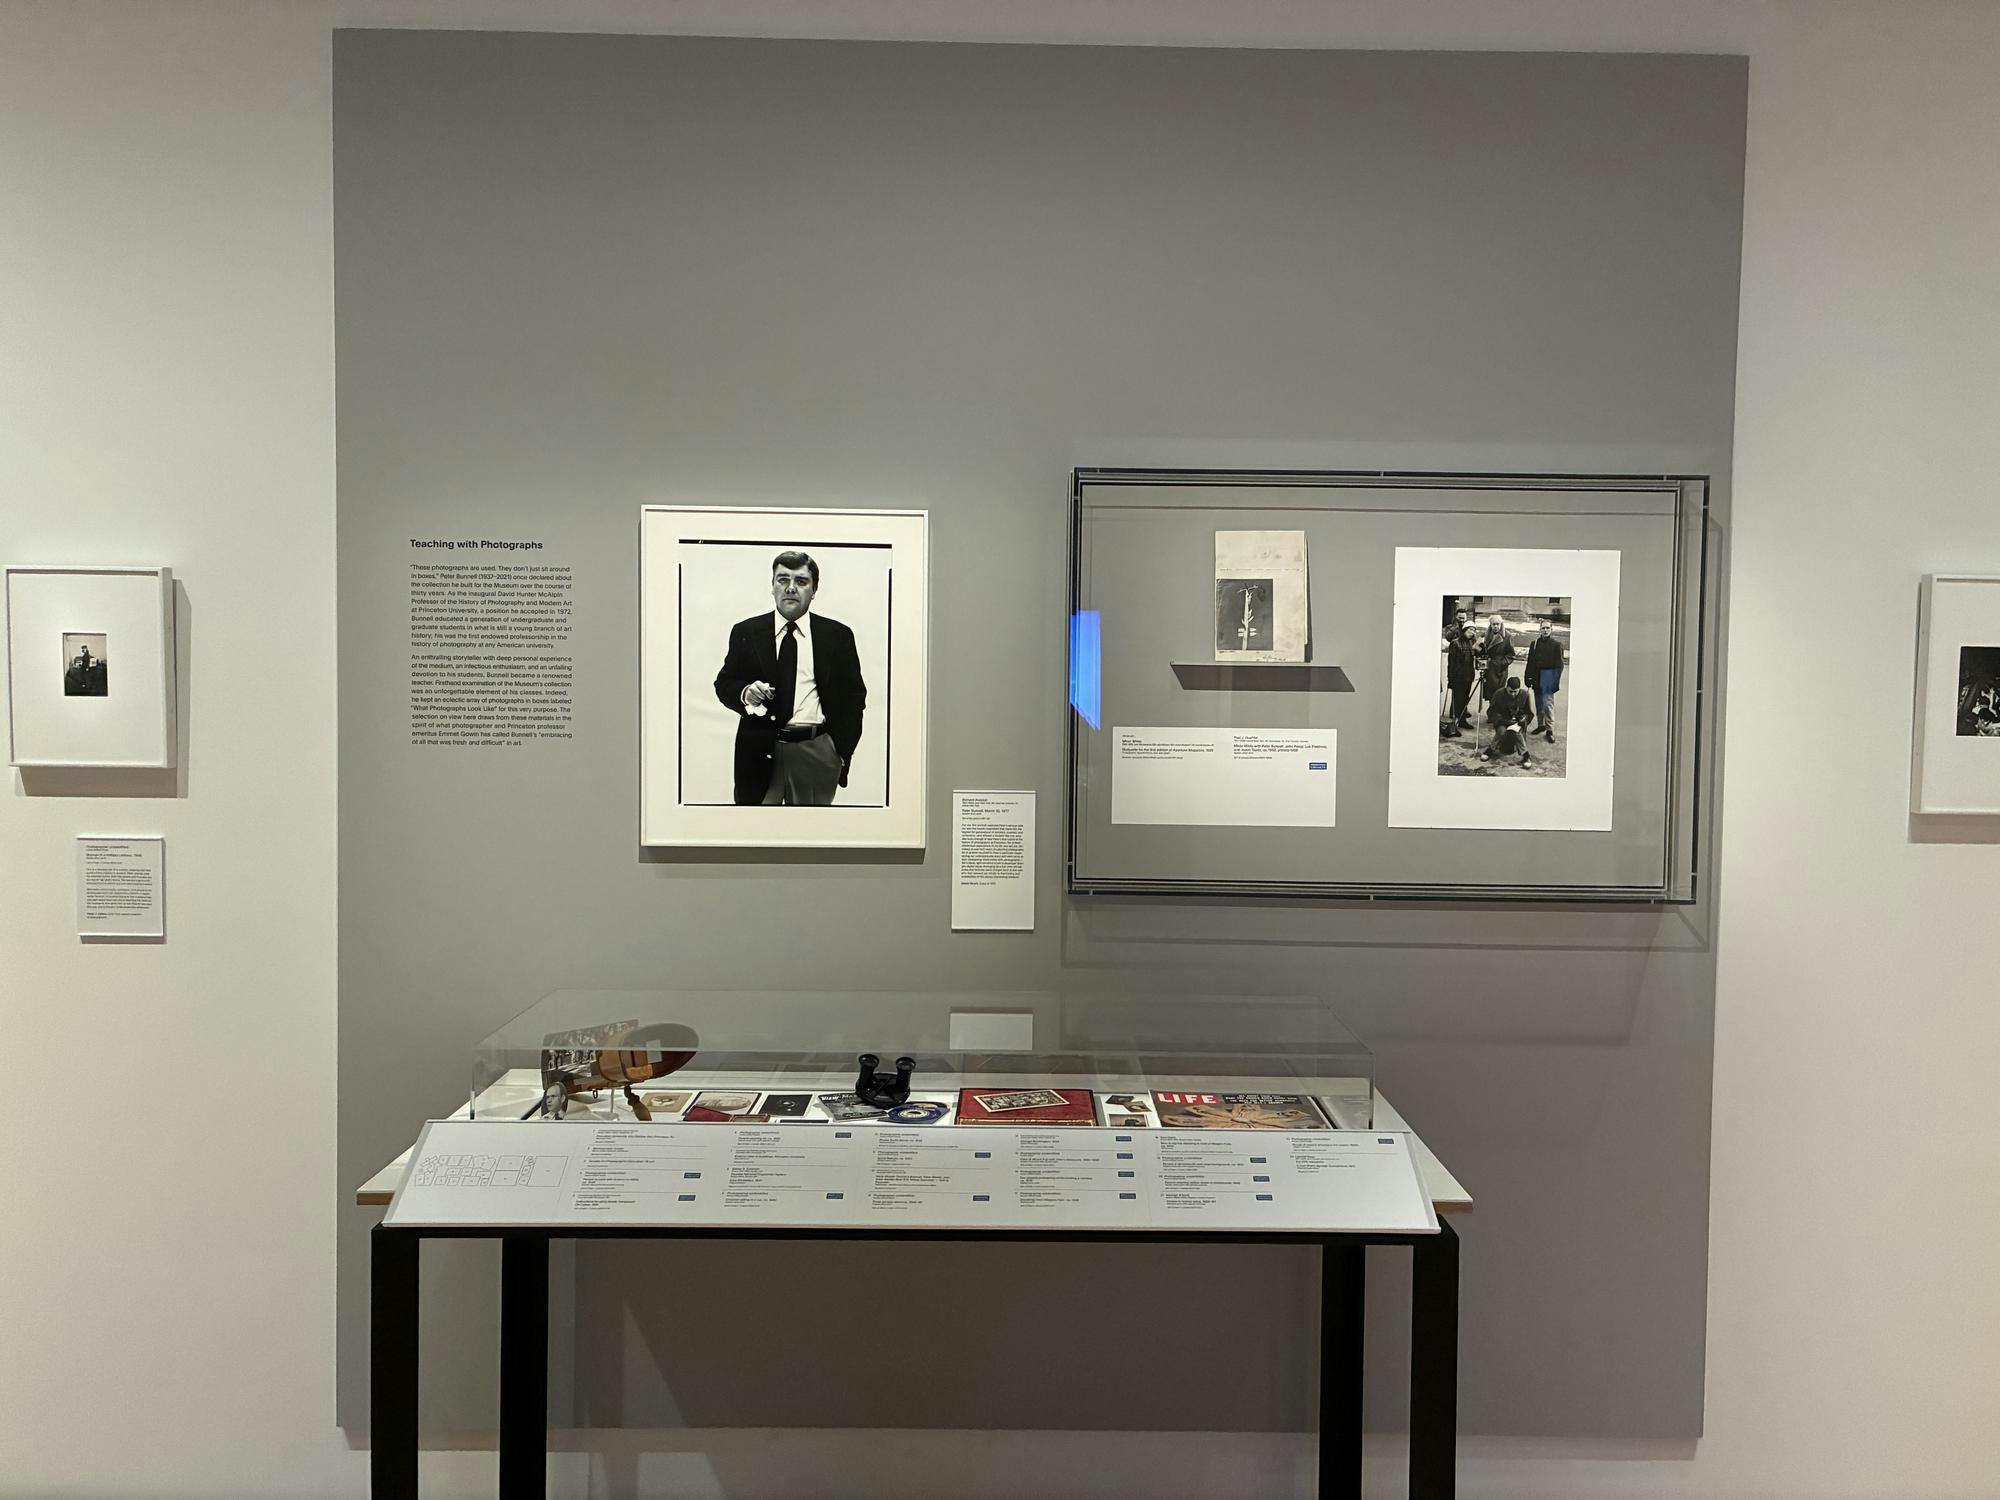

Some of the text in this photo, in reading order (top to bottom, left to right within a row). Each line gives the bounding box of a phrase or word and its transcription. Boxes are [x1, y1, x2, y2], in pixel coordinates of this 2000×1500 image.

[410, 540, 454, 549] Teaching
[481, 541, 543, 550] Photographs
[410, 590, 427, 598] thirty
[537, 591, 563, 599] McAlpin
[487, 599, 525, 607] Photography
[447, 607, 479, 615] University,
[509, 616, 554, 624] undergraduate
[509, 633, 549, 641] professorship
[512, 655, 538, 663] personal
[433, 688, 474, 696] unforgettable
[1157, 1093, 1217, 1104] LIFE
